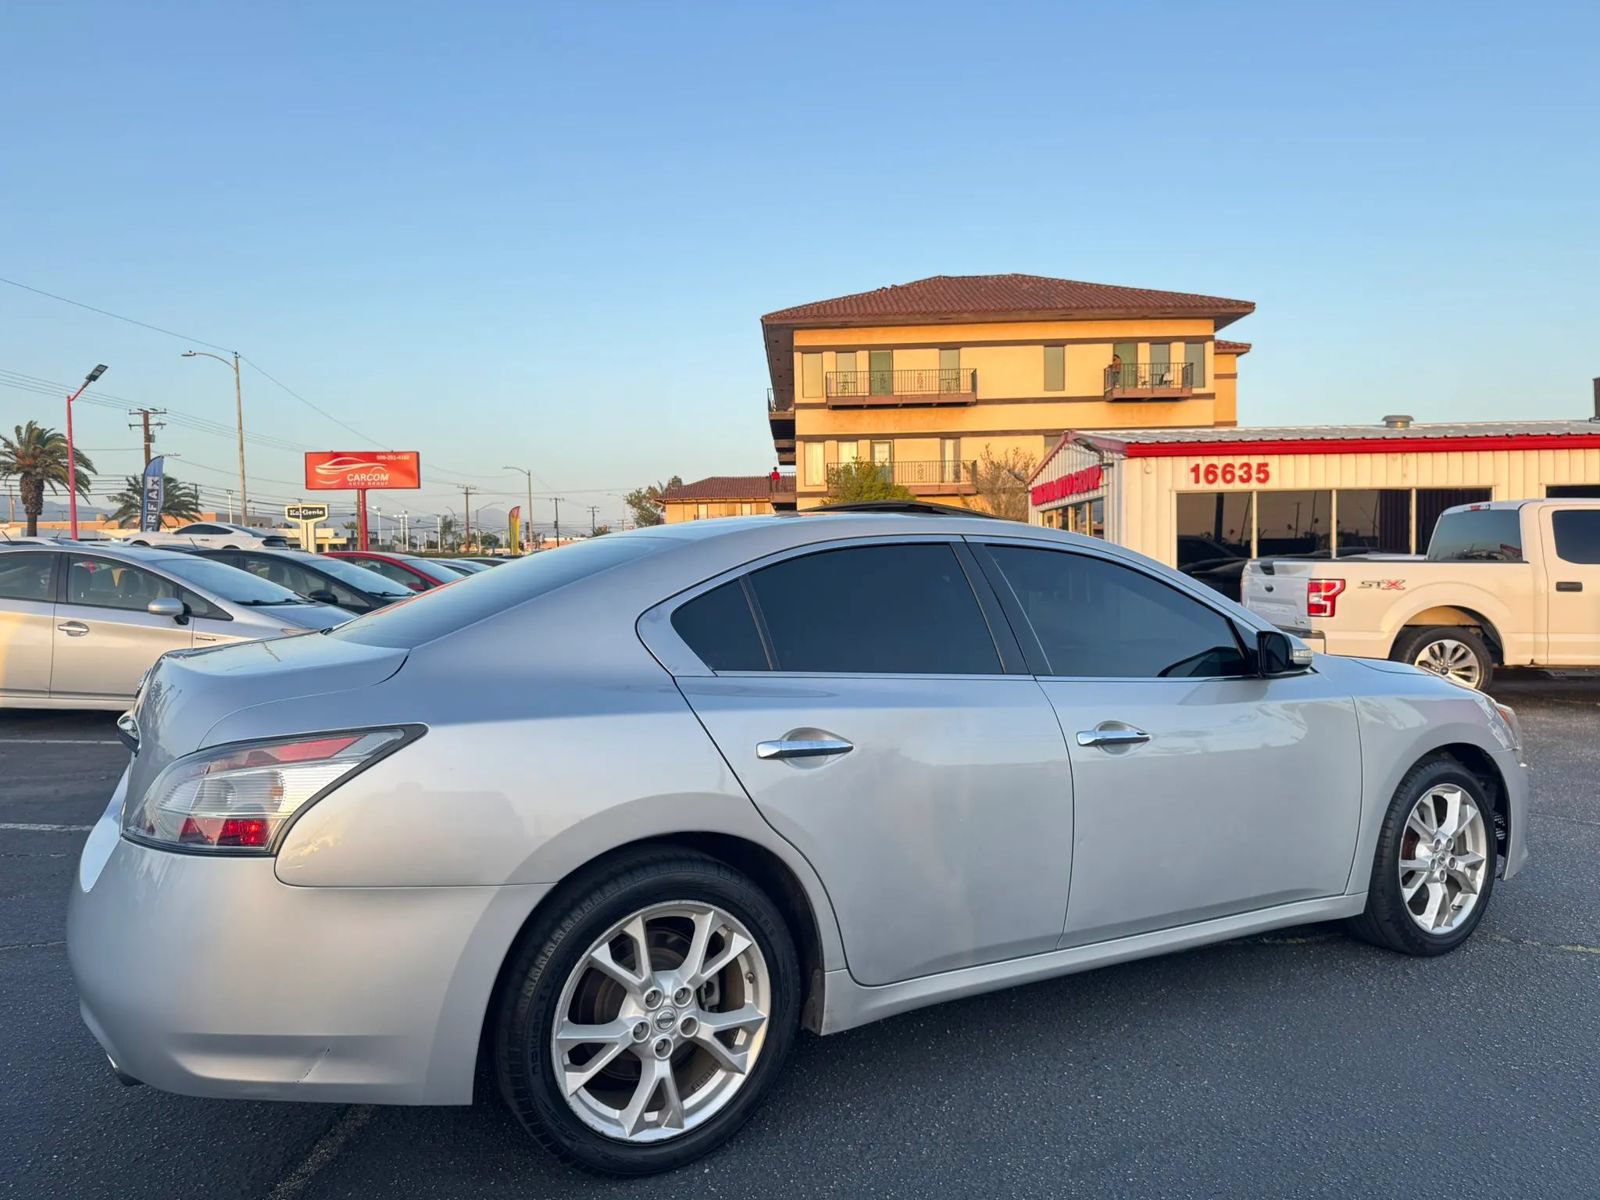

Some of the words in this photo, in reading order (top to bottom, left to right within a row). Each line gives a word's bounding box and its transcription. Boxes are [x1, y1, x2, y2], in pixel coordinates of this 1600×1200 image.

[347, 473, 389, 481] CARCOM
[1190, 462, 1270, 484] 16635
[146, 479, 160, 532] ARFAX
